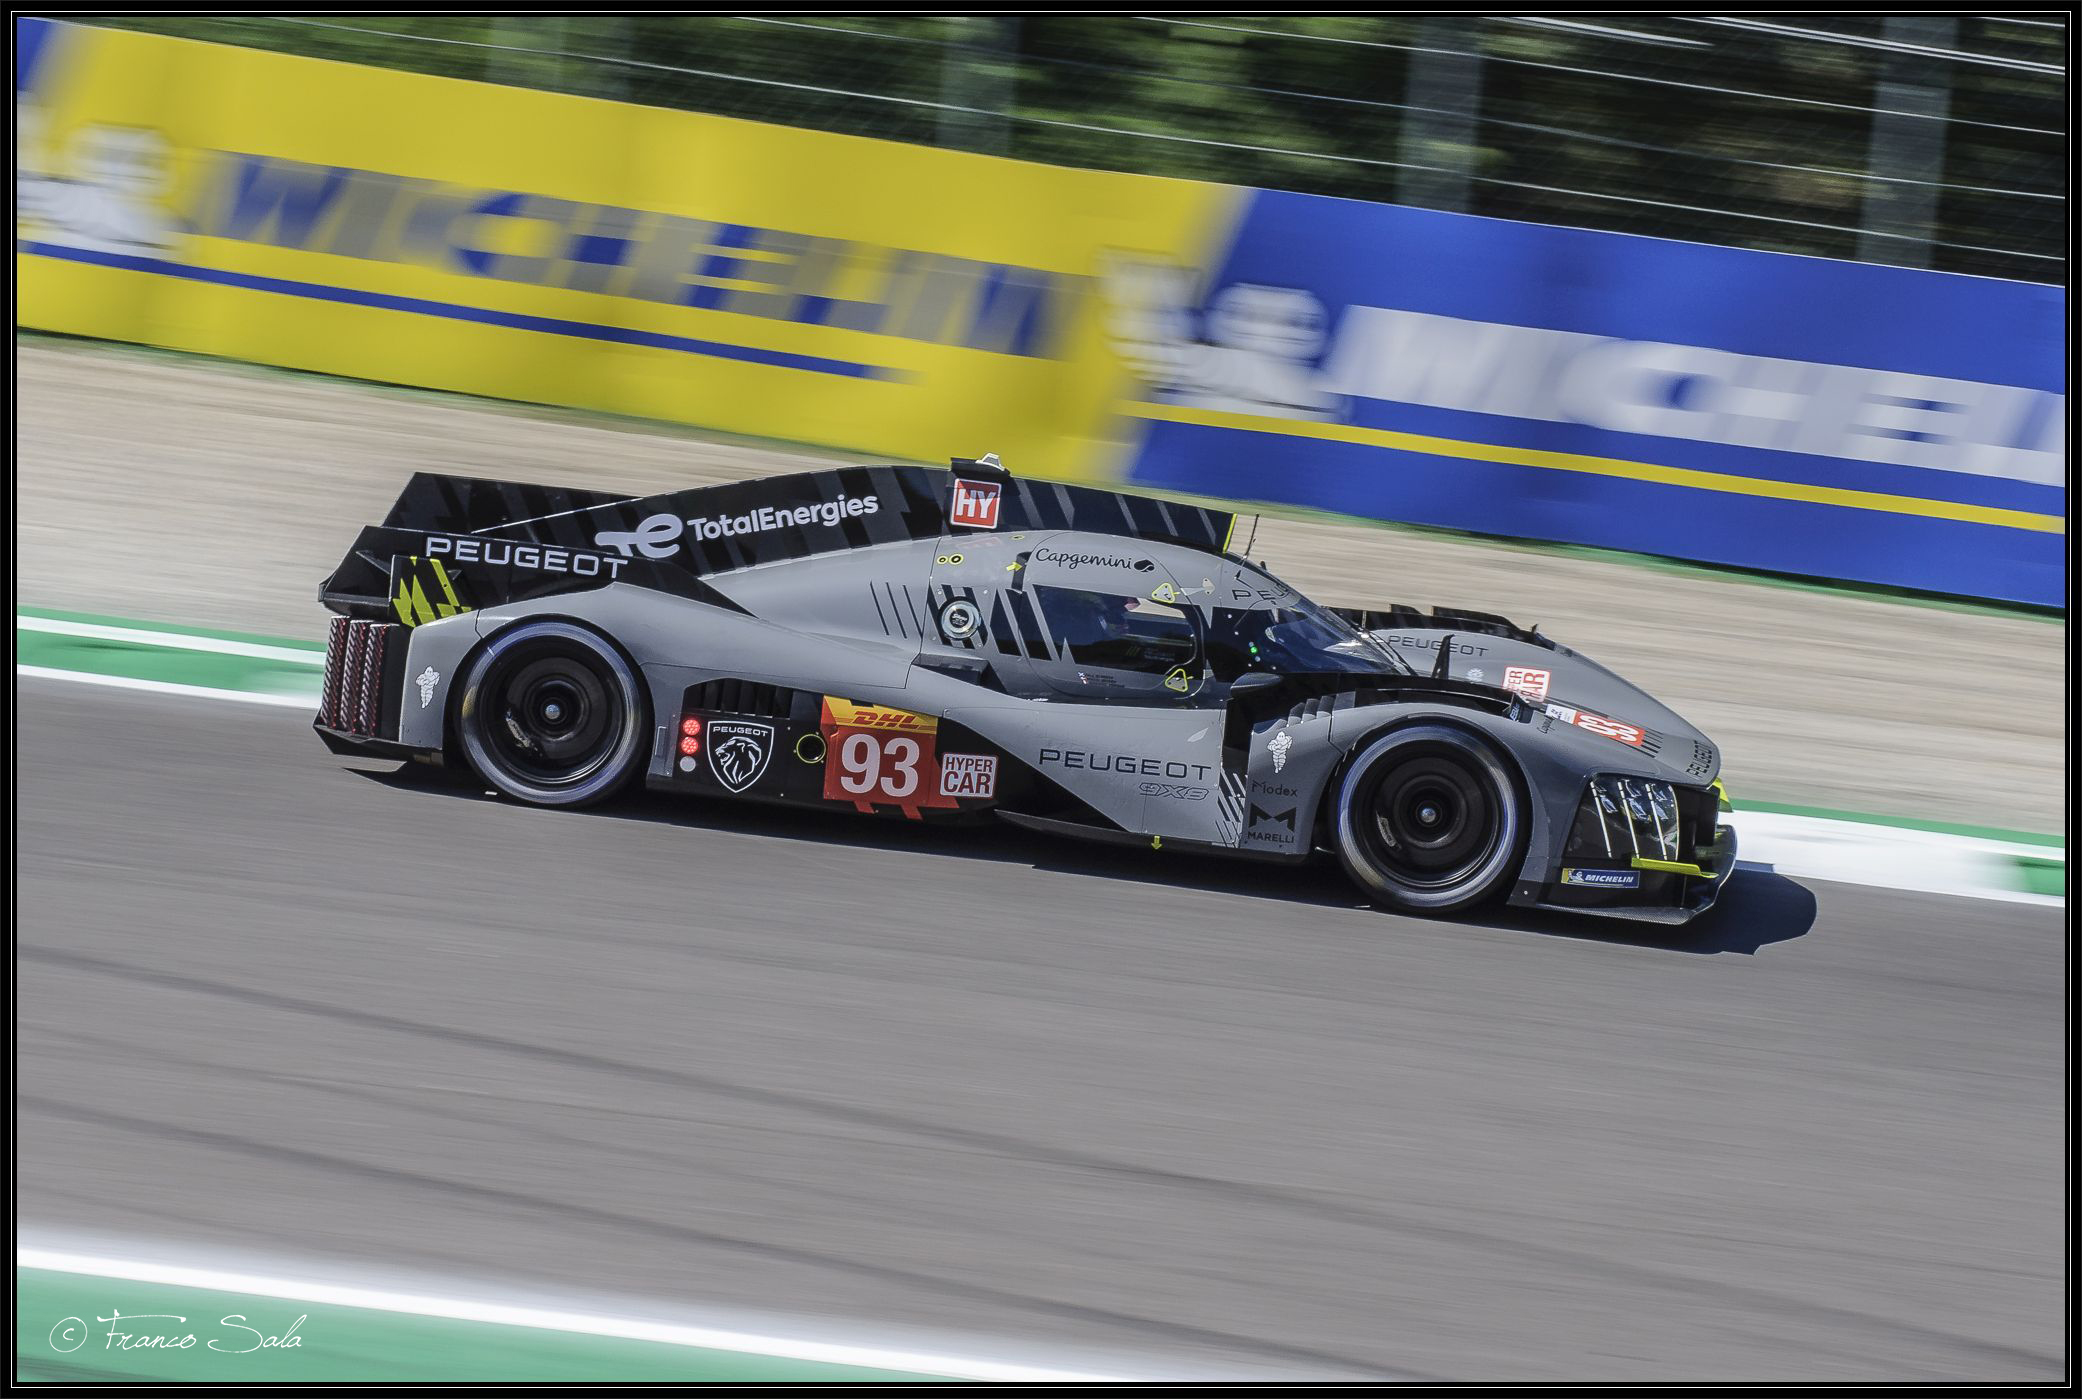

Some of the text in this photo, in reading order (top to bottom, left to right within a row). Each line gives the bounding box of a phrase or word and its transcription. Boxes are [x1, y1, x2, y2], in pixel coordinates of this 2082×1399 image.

[955, 488, 997, 519] HY
[686, 494, 879, 541] TotalEnergies
[425, 536, 629, 579] PEUGEOT
[1035, 548, 1132, 570] Capgemini
[712, 726, 769, 737] PEUGEOT
[852, 710, 921, 730] DHL
[1577, 714, 1640, 742] 93
[840, 733, 921, 797] 93
[945, 756, 993, 773] HYPER
[1039, 748, 1212, 781] PEUGEOT
[943, 770, 992, 794] CAR
[1247, 831, 1295, 844] MARELLI
[1585, 874, 1635, 884] MICHELIN
